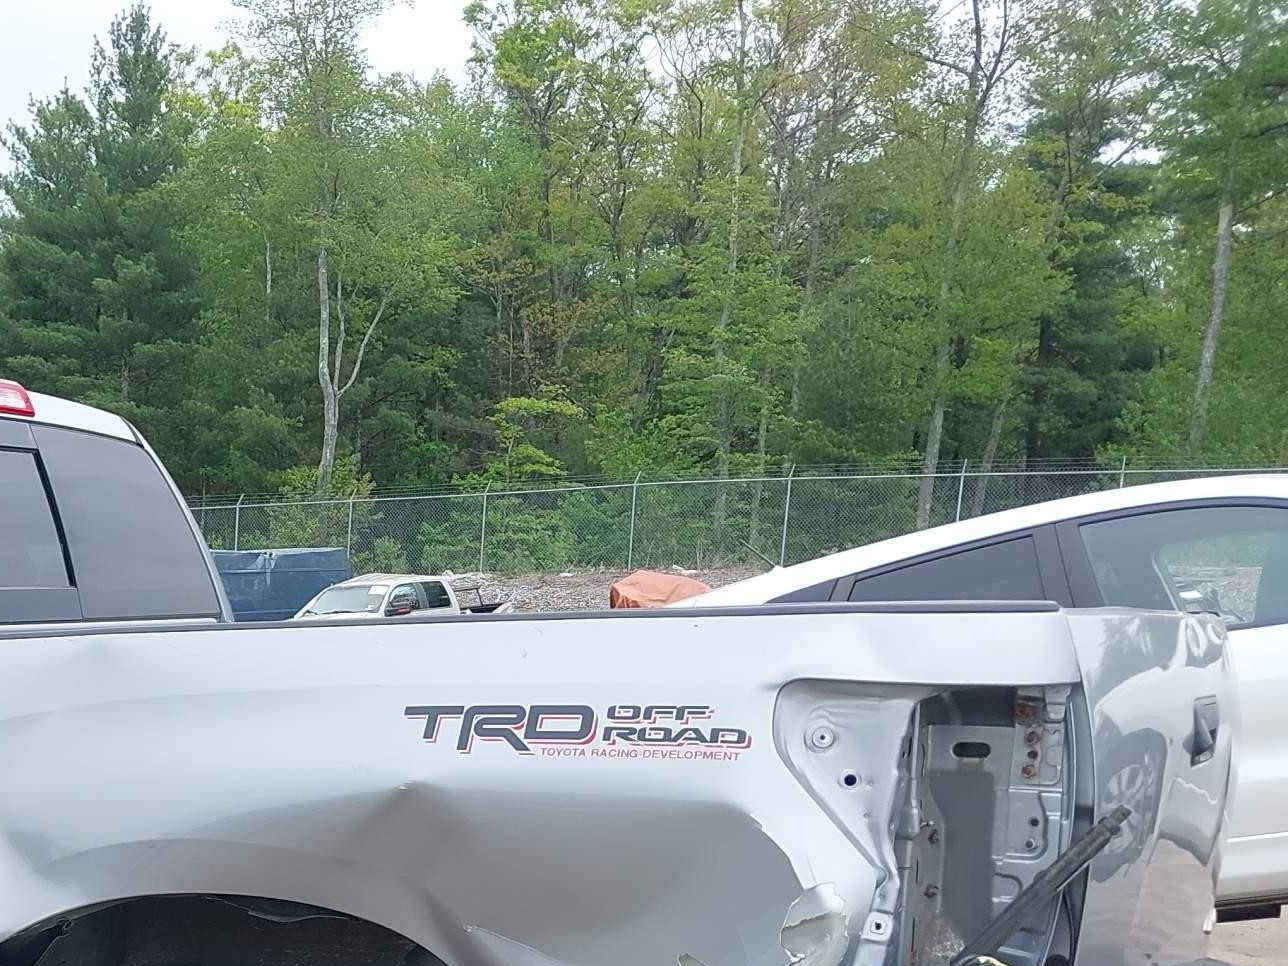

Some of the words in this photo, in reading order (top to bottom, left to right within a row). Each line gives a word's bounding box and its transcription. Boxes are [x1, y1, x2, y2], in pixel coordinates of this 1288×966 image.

[606, 704, 716, 725] OFF
[403, 704, 599, 756] TRD
[601, 726, 753, 749] ROAD
[539, 746, 587, 759] TOYOTA
[590, 747, 638, 760] RACING
[641, 749, 742, 762] DEVELOPMENT
